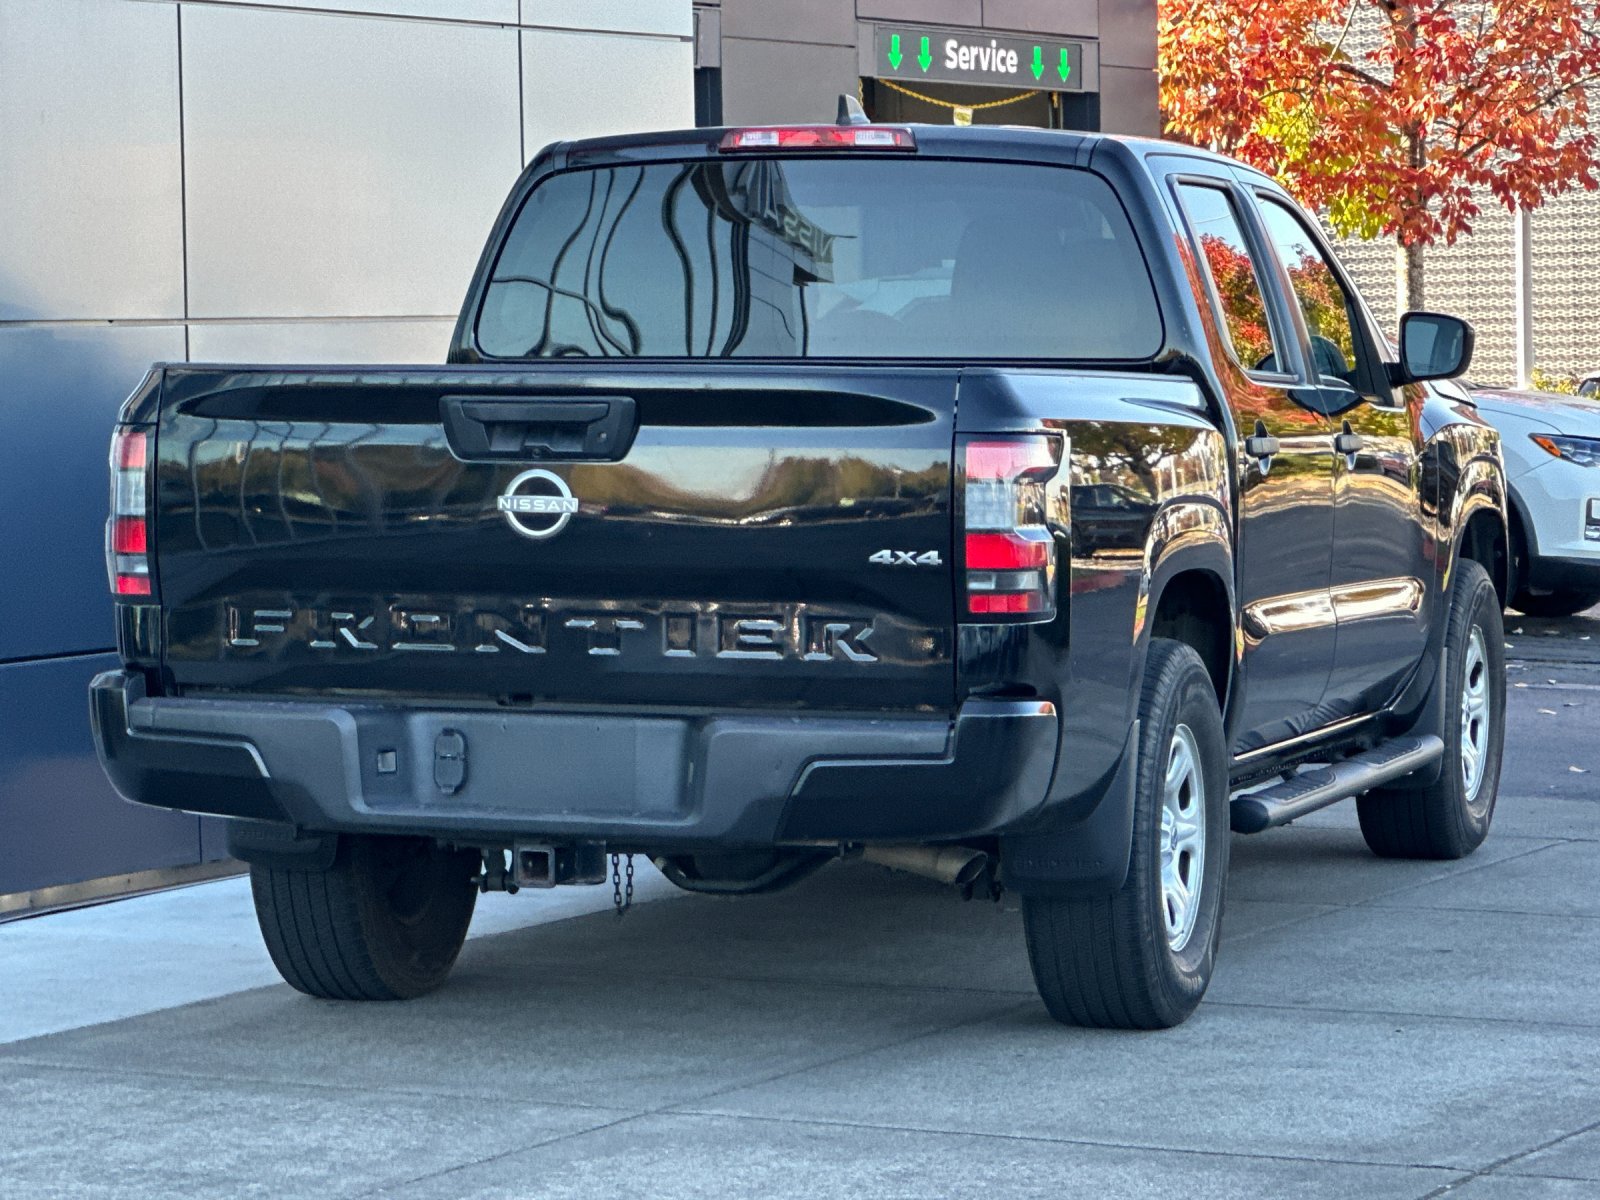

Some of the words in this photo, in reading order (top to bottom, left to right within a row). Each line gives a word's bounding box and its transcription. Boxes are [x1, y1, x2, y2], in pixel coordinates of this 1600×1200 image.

[944, 38, 1019, 74] Service
[499, 497, 576, 511] NISSAN
[226, 604, 878, 662] FRONTIER
